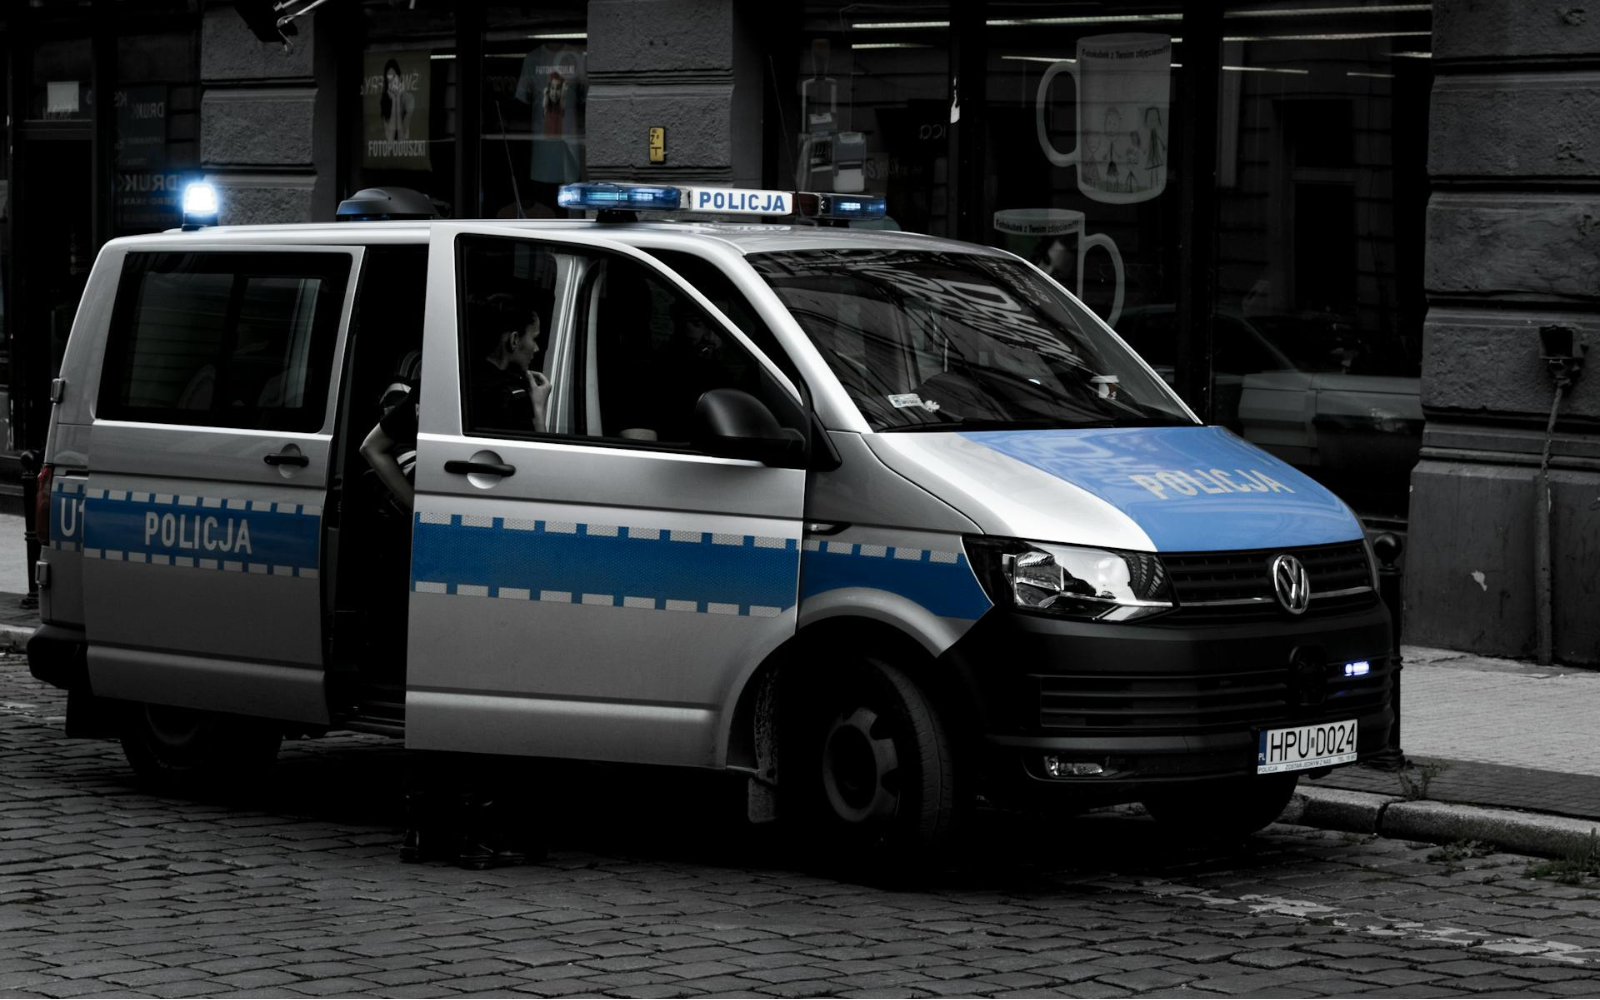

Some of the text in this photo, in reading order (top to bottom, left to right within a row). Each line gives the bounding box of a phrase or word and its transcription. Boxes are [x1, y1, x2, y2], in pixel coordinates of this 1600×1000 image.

[368, 140, 426, 158] FOTOPODUSZKI
[699, 190, 787, 213] POLICJA
[1128, 468, 1296, 500] POLICJA
[144, 511, 252, 554] POLICJA
